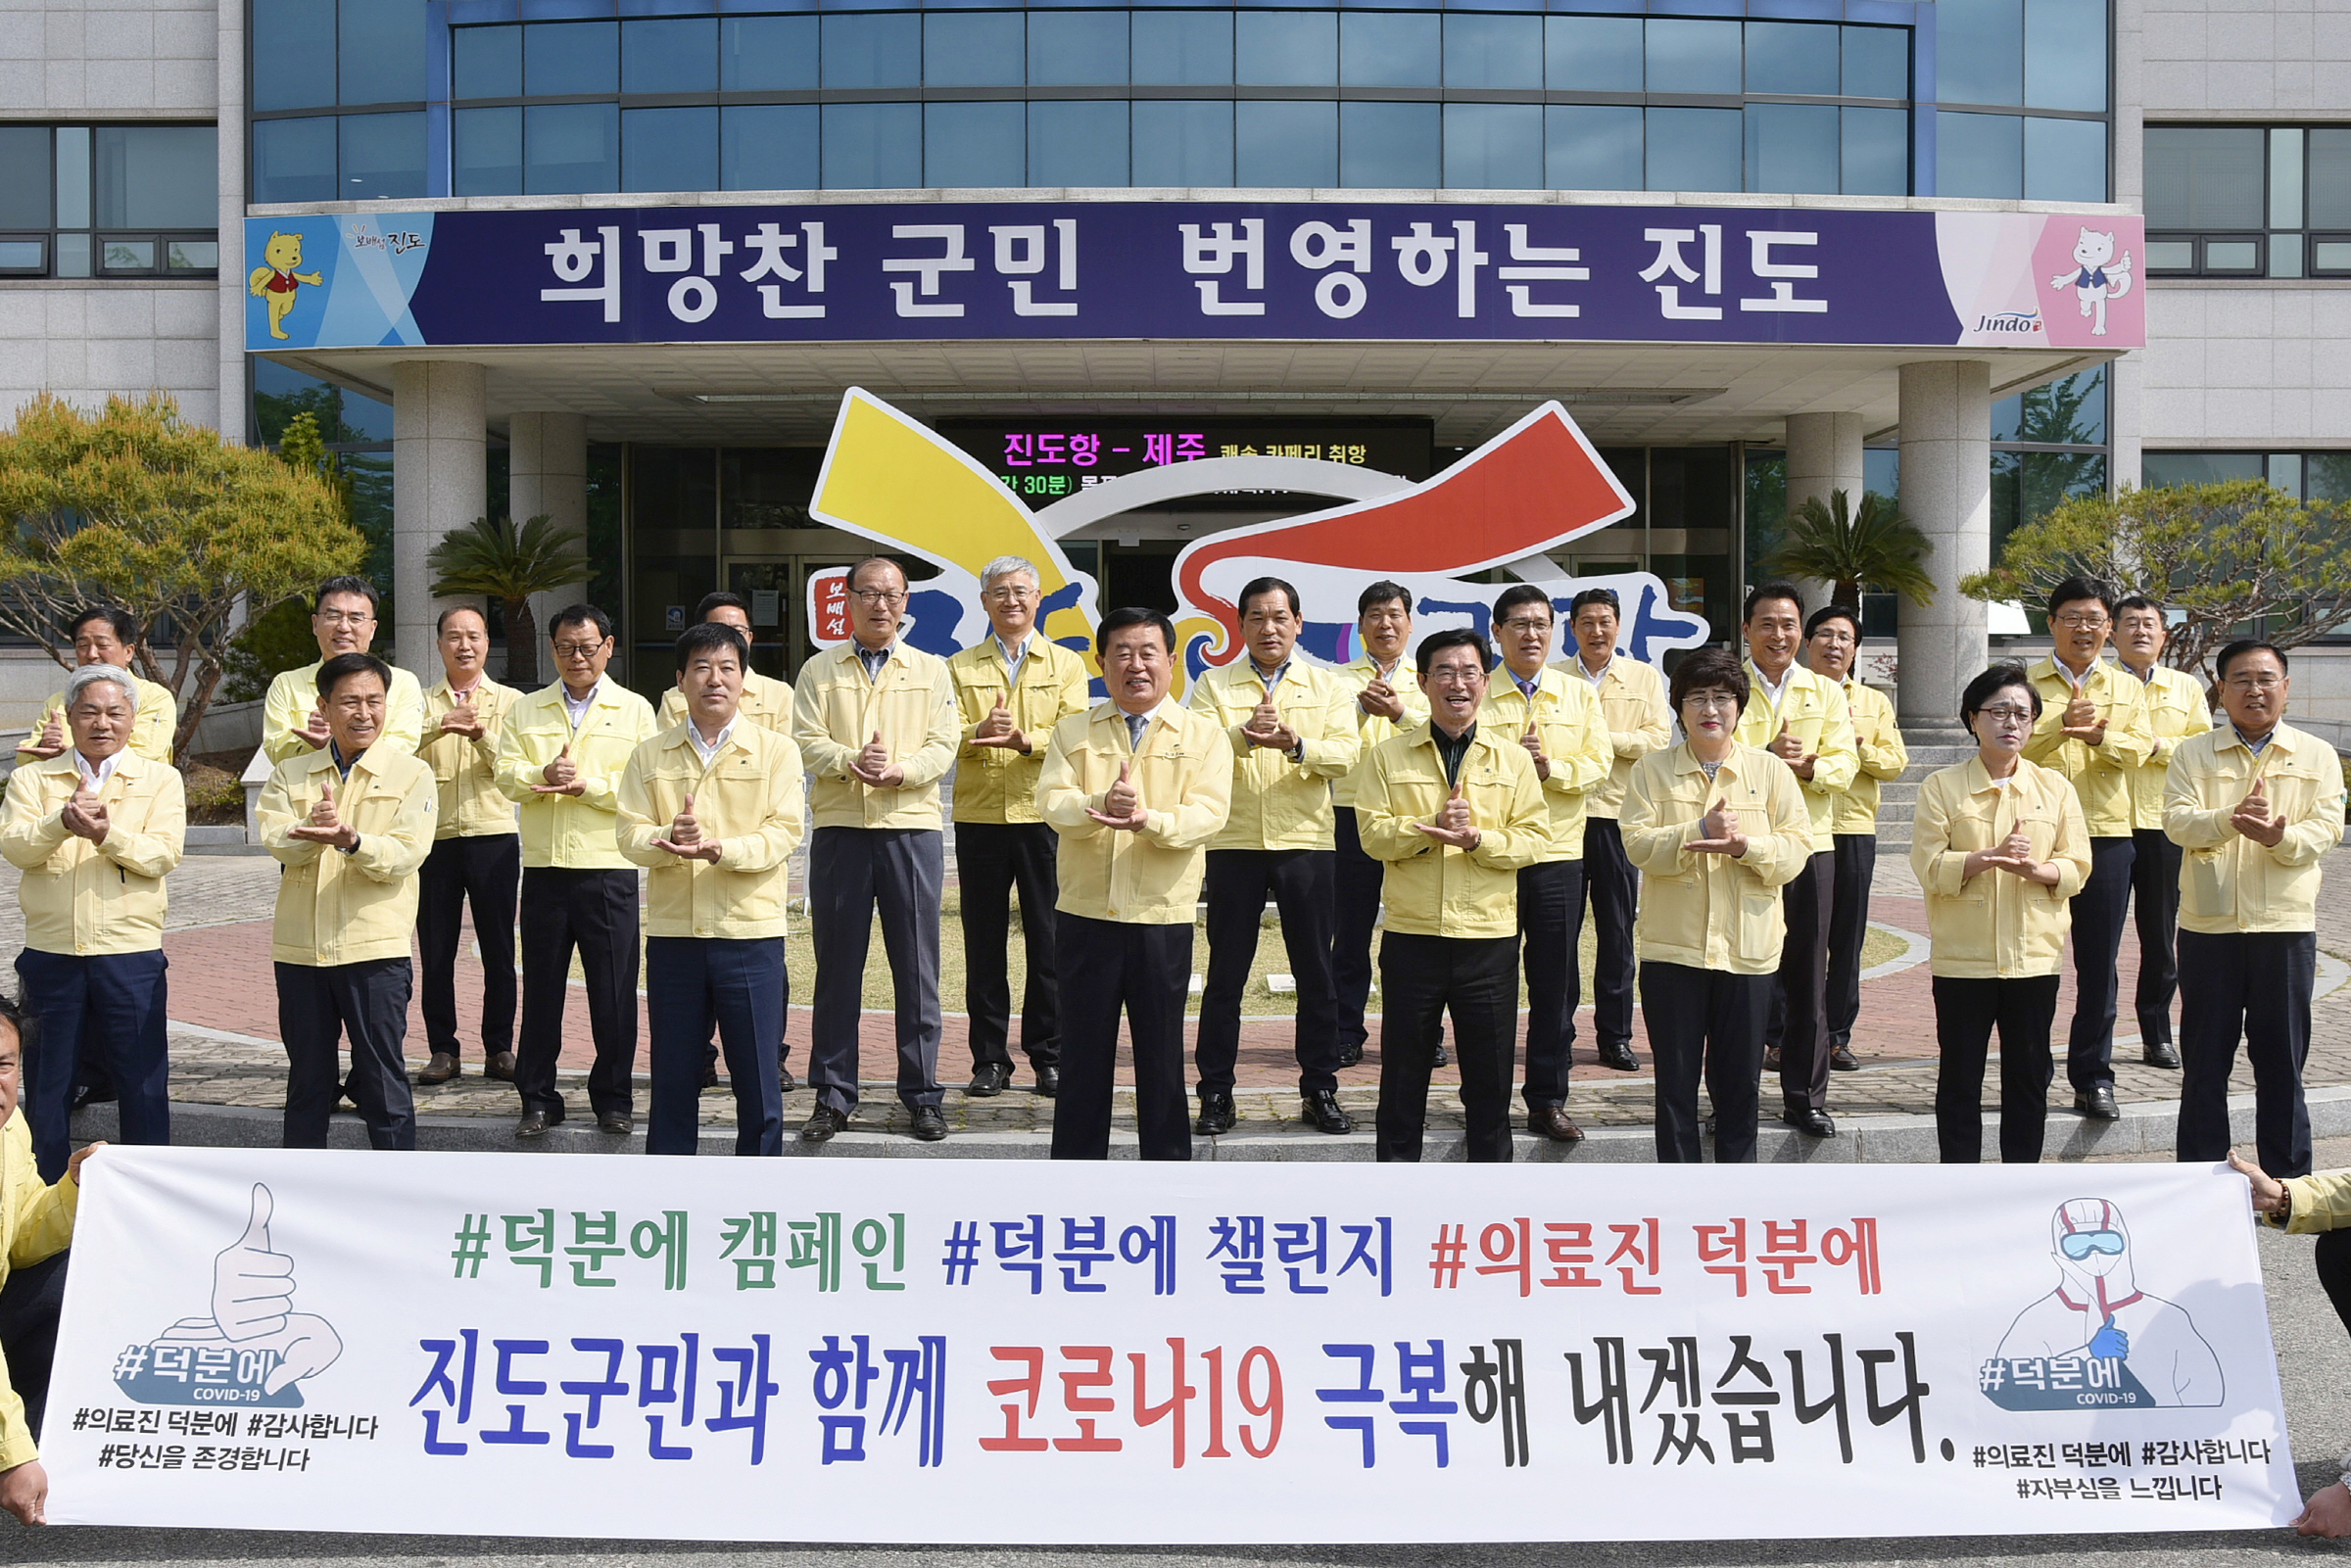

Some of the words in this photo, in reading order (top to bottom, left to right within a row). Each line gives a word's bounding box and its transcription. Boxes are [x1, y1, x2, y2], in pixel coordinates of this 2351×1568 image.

[356, 235, 385, 250] 보배섬
[387, 232, 426, 254] 진도
[541, 221, 838, 323] 희망찬
[883, 218, 1079, 318] 군민
[1178, 218, 1590, 320] 번영하는
[1638, 223, 1829, 321] 진도
[1973, 315, 2031, 332] Jindo
[1004, 433, 1100, 466] 진도항
[1142, 433, 1206, 465] 제주
[1328, 444, 1367, 464] 취항
[1024, 475, 1073, 495] 30분)
[826, 582, 845, 636] 보배섬
[452, 1209, 688, 1291] #덕분에
[719, 1212, 905, 1293] 캠페인
[942, 1213, 1176, 1296] #덕분에
[1206, 1215, 1392, 1298] 챌린지
[1429, 1216, 1662, 1298] #의료진
[1692, 1217, 1882, 1298] 덕분에
[113, 1345, 276, 1385] #덕분에
[1980, 1356, 2123, 1392] #덕분에
[192, 1387, 262, 1402] COVID-19
[408, 1328, 780, 1466] 진도군민과
[808, 1335, 947, 1468] 함께
[979, 1337, 1284, 1469] 코로나19
[1315, 1338, 1530, 1469] 극복해
[1563, 1331, 1955, 1466] 내겠습니다.
[2076, 1392, 2137, 1405] COVID-19
[72, 1407, 162, 1434] #의료진
[168, 1410, 239, 1438] 덕분에
[247, 1413, 379, 1441] #감사합니다
[98, 1443, 187, 1469] #당신을
[192, 1446, 311, 1472] 존경합니다
[1972, 1443, 2056, 1469] #의료진
[2061, 1441, 2133, 1468] 덕분에
[2140, 1438, 2272, 1466] #감사합니다
[2016, 1477, 2123, 1501] #자부심을
[2130, 1474, 2223, 1501] 느낍니다
